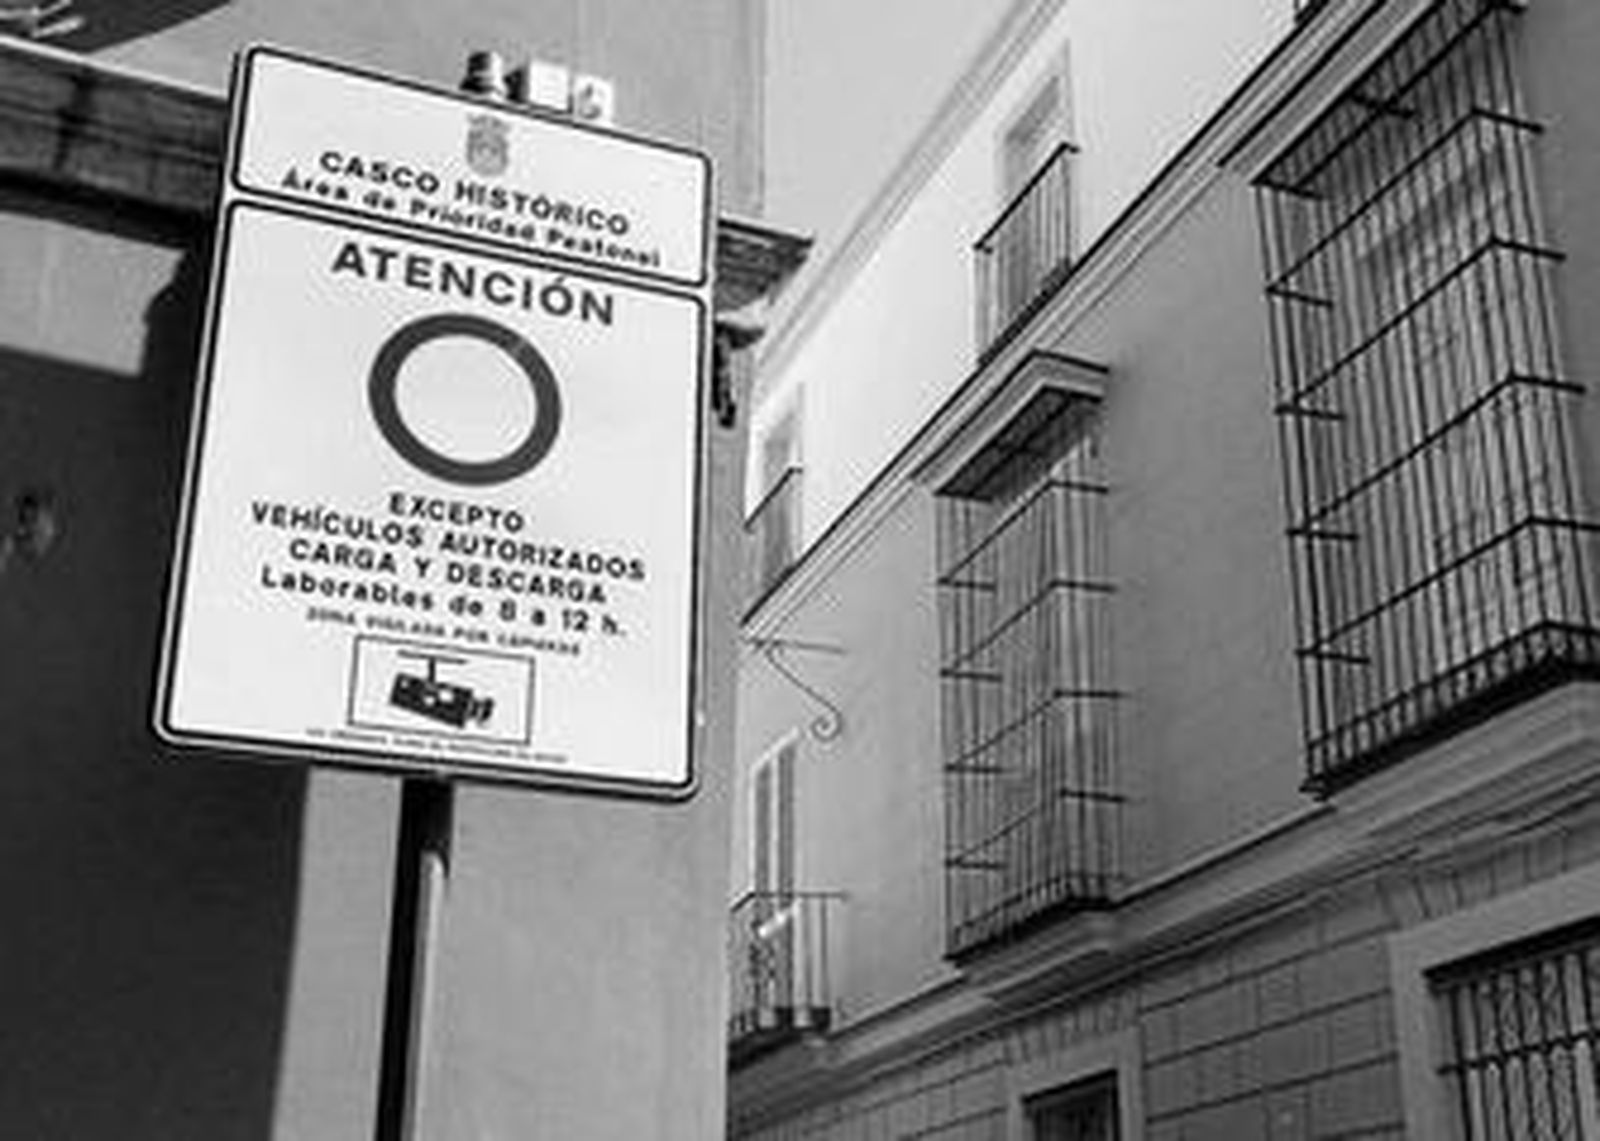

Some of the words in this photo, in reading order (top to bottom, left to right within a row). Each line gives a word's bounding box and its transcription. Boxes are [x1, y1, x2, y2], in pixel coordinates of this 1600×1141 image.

[319, 150, 440, 194] CASCO
[330, 242, 613, 325] ATENCIÓN
[252, 500, 424, 549] VEHÍCULOS
[439, 531, 646, 582] AUTORIZADOS
[389, 491, 524, 534] EXCEPTO
[261, 563, 434, 612] Laborables
[449, 595, 484, 616] de
[562, 608, 590, 632] 12
[289, 537, 398, 575] CARGA
[414, 556, 432, 579] Y
[447, 560, 607, 604] DESCARGA
